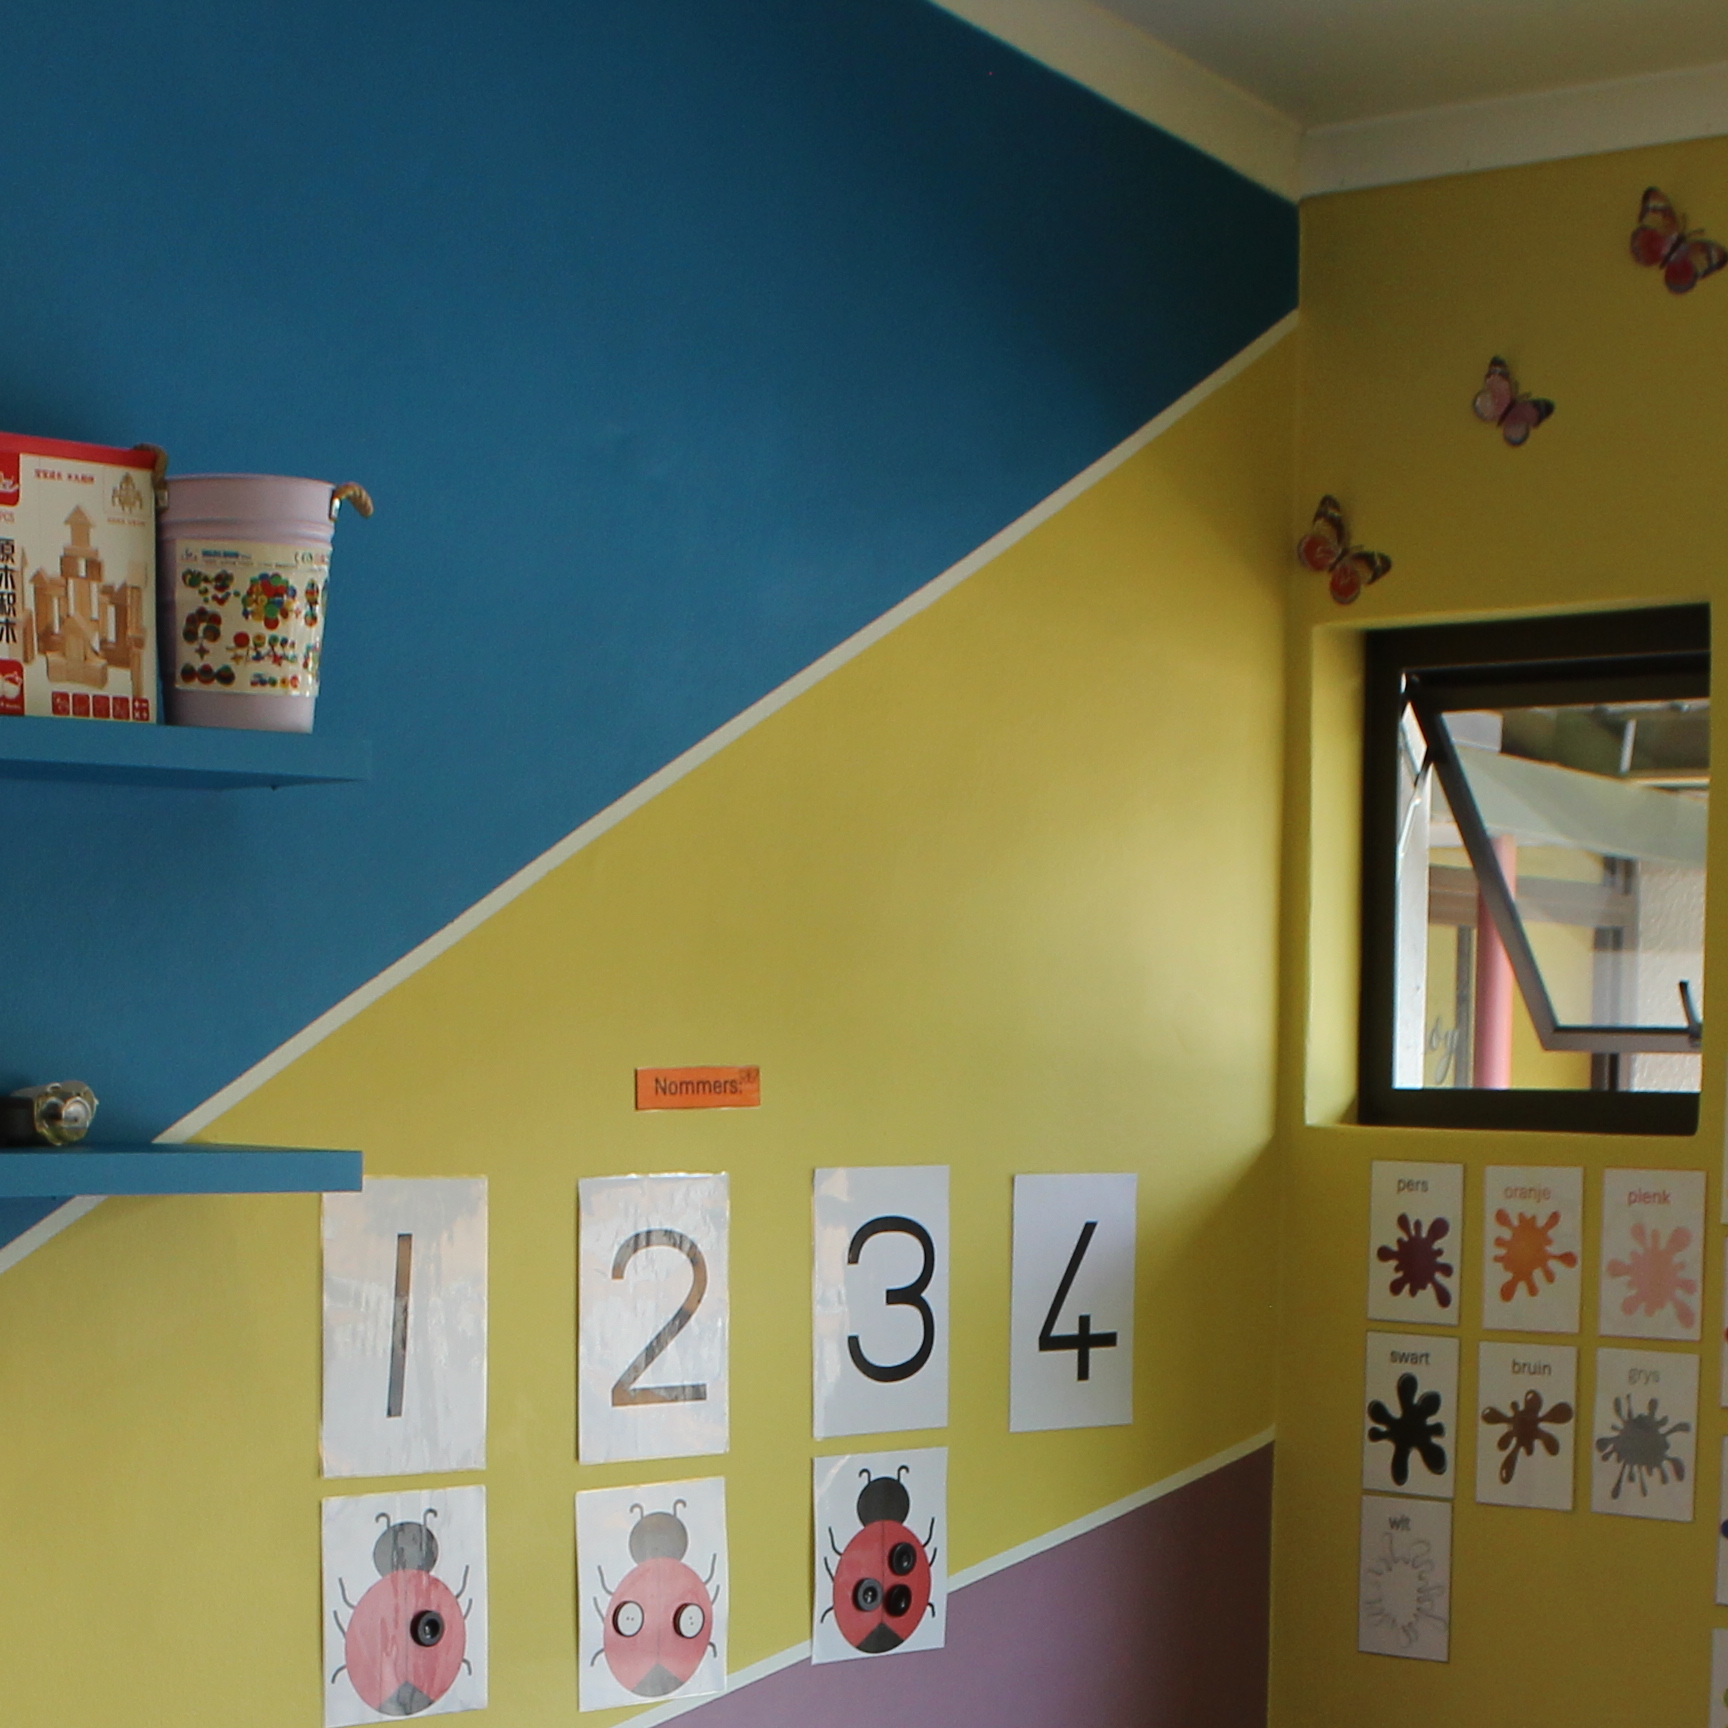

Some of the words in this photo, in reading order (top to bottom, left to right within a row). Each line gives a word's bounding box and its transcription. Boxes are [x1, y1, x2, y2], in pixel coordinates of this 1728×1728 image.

[655, 1077, 743, 1096] Nommers:
[1397, 1177, 1429, 1195] pers
[1504, 1184, 1552, 1204] oranje
[1627, 1189, 1671, 1206] pienk
[847, 1215, 935, 1383] 3
[1038, 1220, 1118, 1381] 4
[386, 1233, 413, 1418] 1
[611, 1228, 708, 1408] 2
[1389, 1349, 1431, 1366] swart
[1511, 1359, 1552, 1377] bruin
[1628, 1366, 1660, 1385] grys
